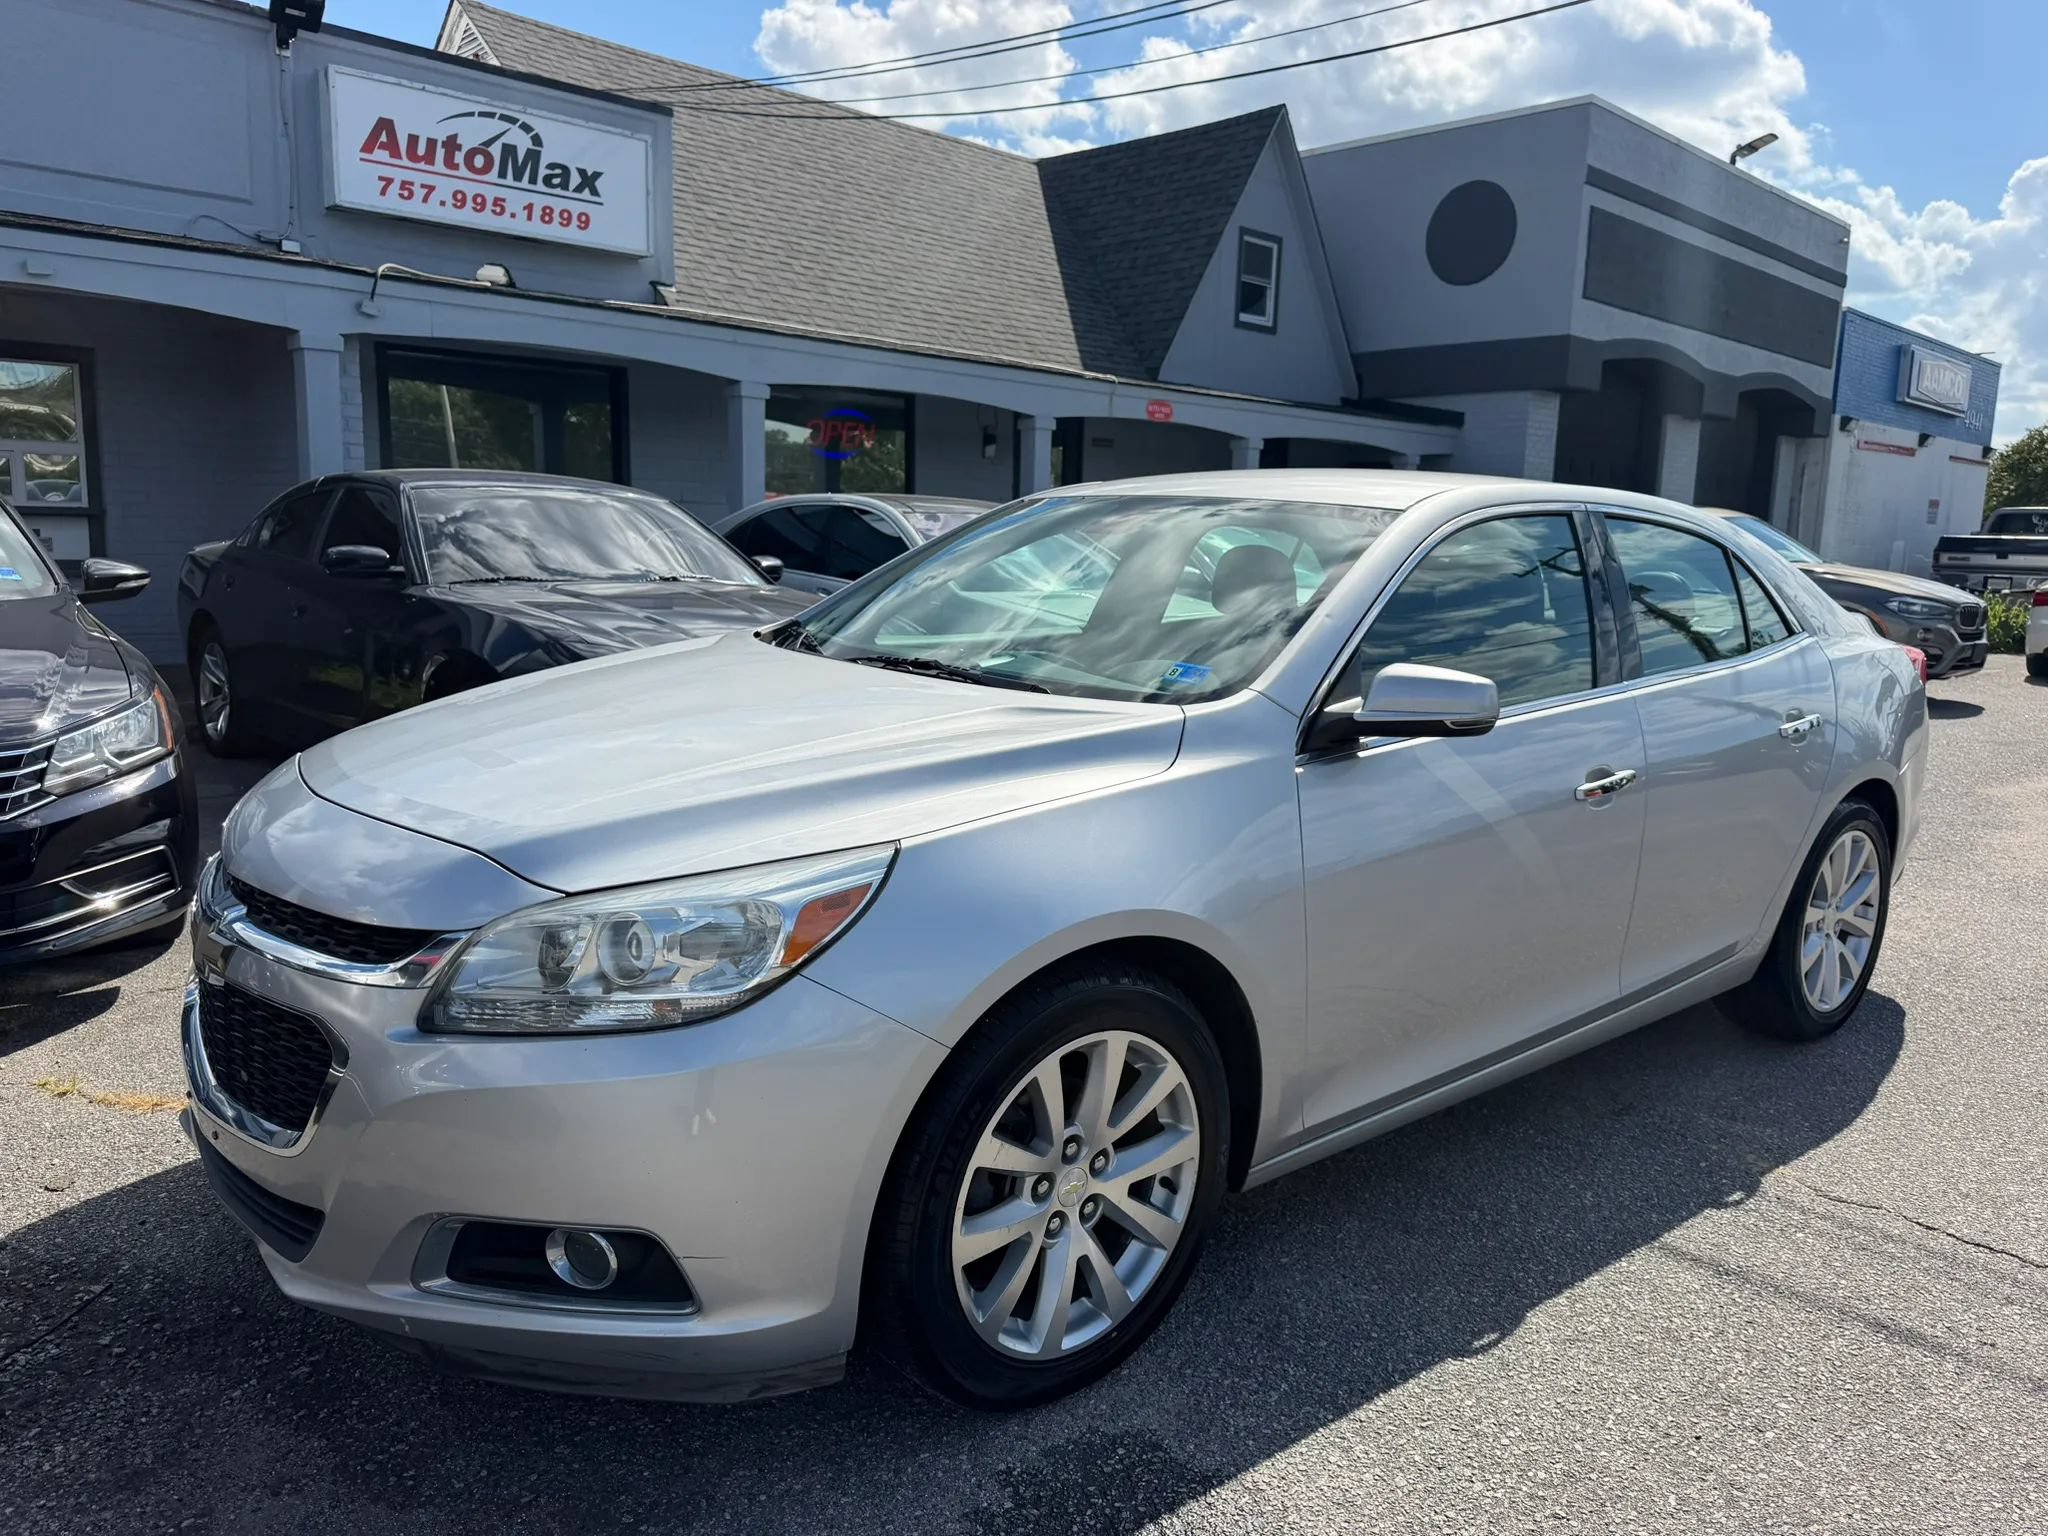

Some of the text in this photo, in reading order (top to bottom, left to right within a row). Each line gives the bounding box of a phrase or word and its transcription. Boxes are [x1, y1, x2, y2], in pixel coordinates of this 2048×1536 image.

[359, 116, 604, 197] AutoMax
[377, 175, 592, 231] 757.995.1899
[807, 418, 877, 448] OPEN
